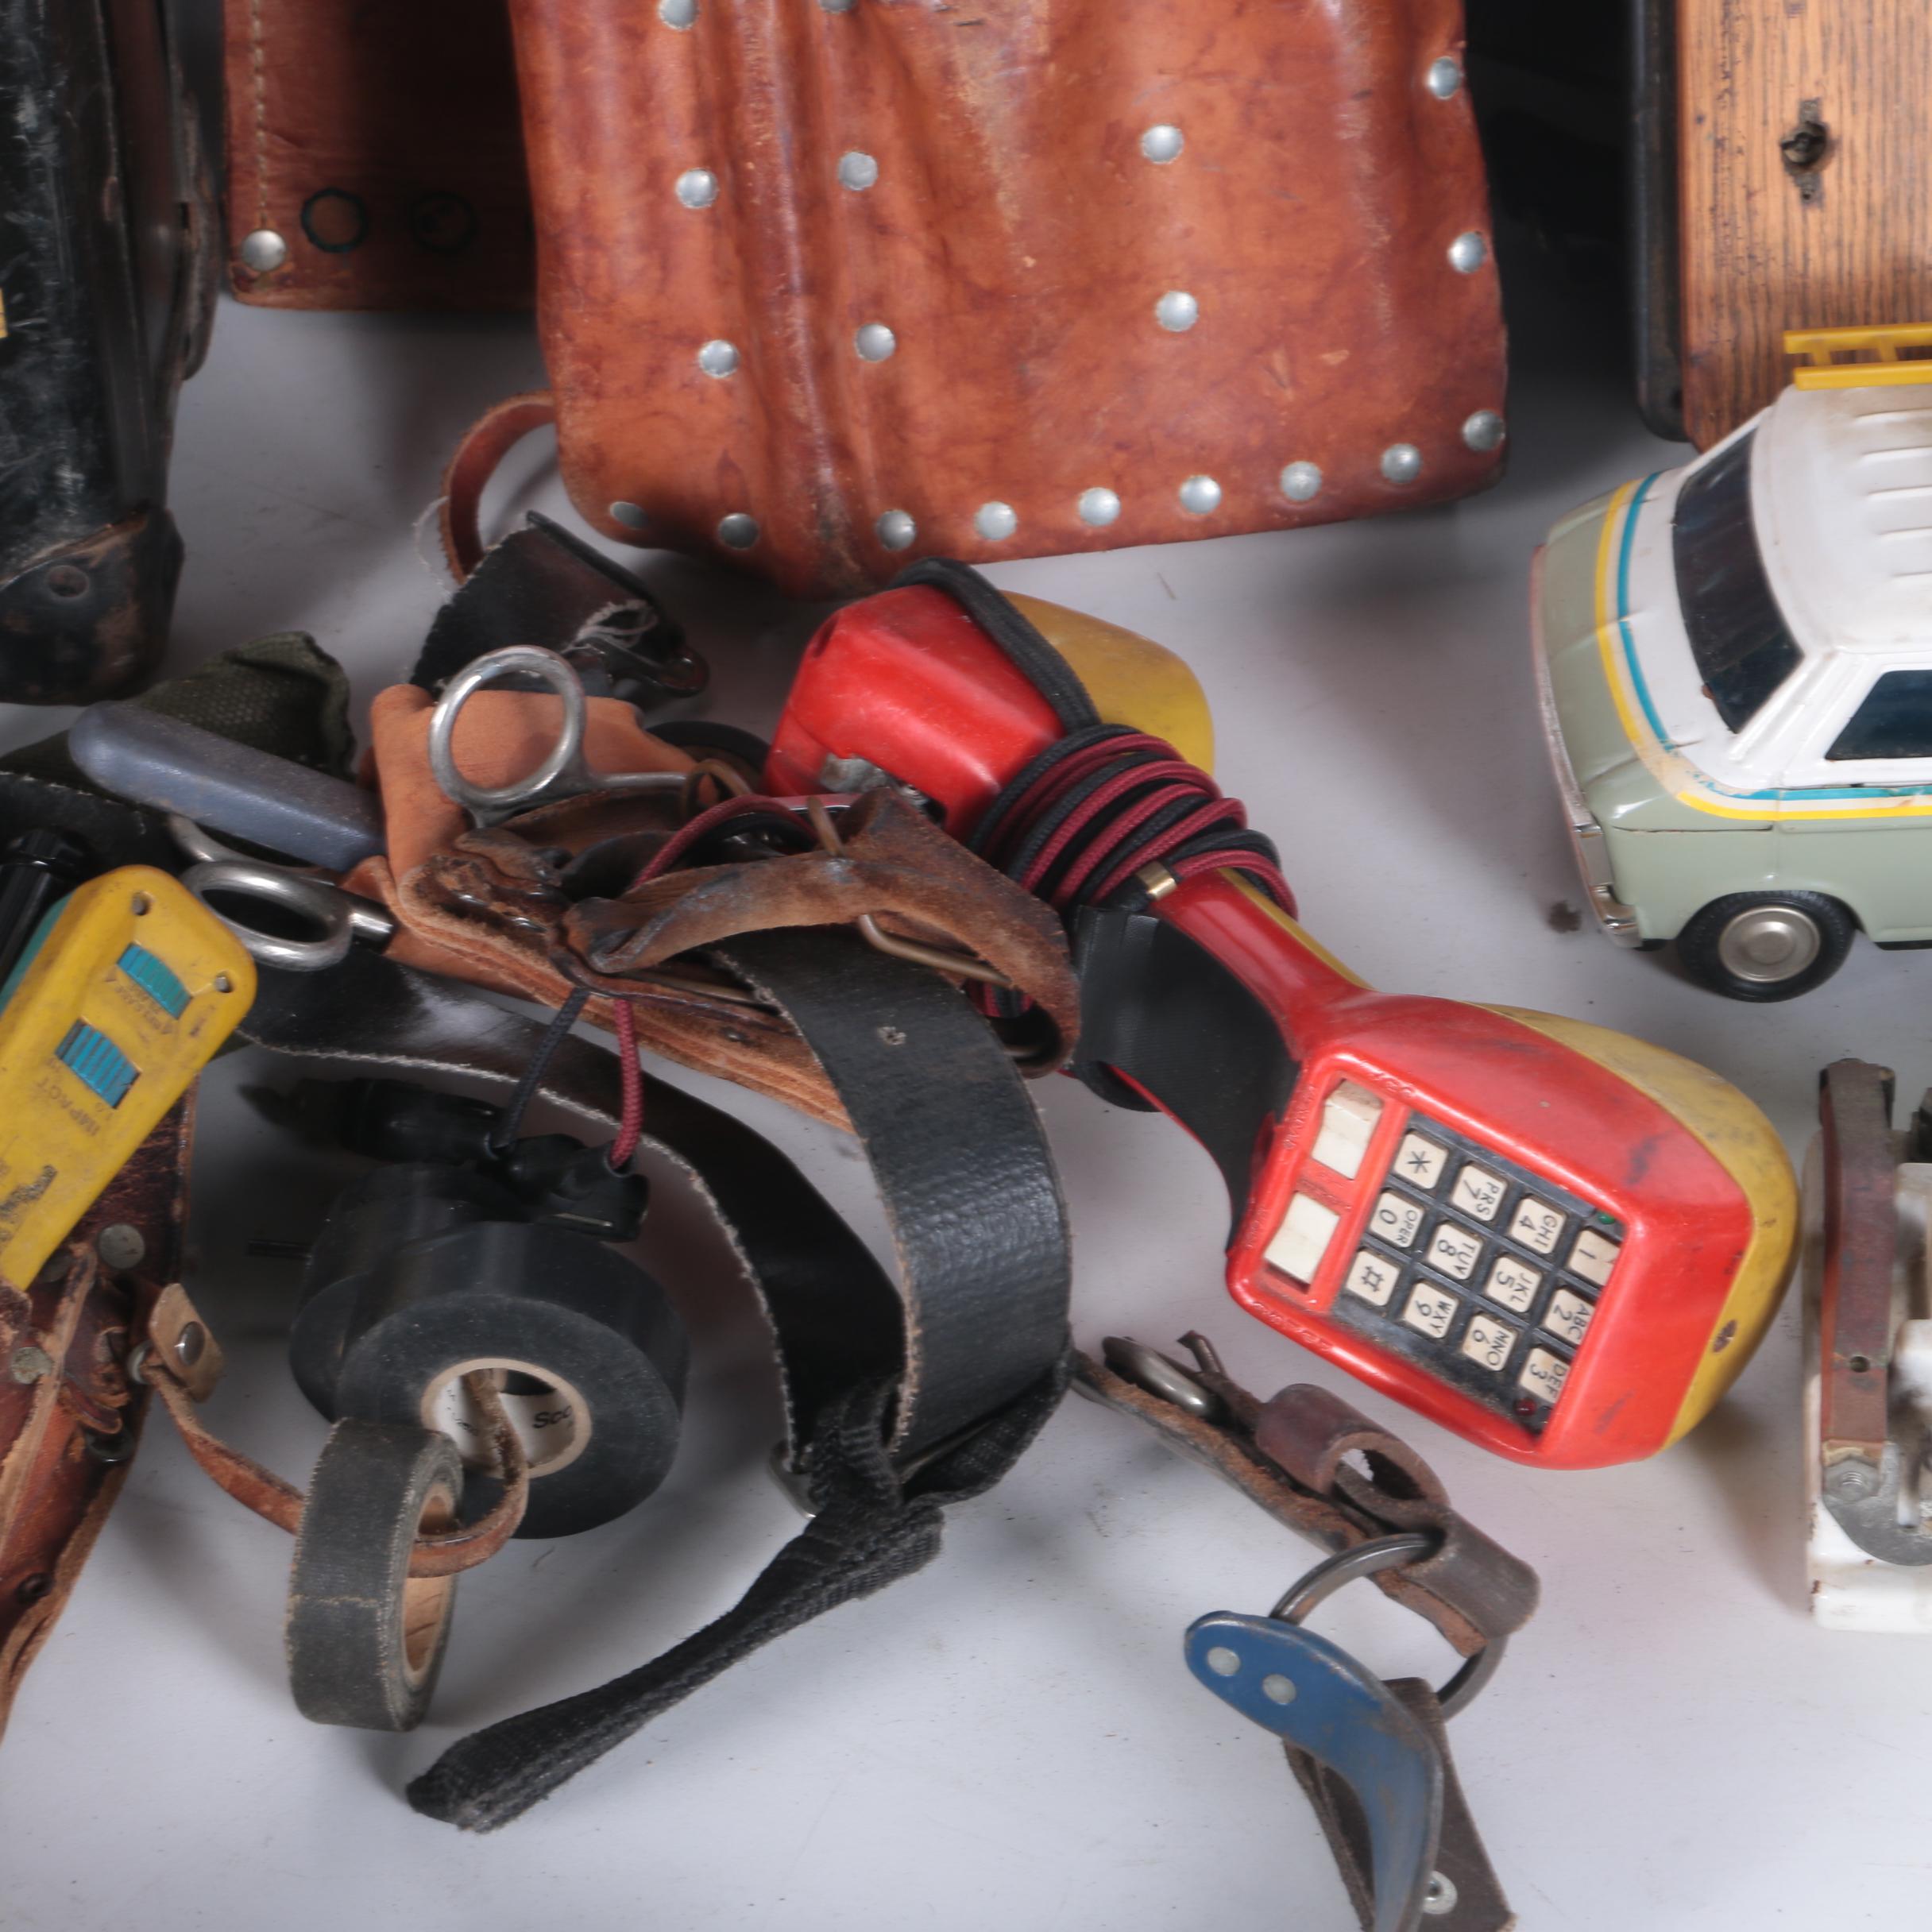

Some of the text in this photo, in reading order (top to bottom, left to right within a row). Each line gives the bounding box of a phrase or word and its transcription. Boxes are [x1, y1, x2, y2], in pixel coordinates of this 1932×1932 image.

[1463, 1179, 1480, 1200] 7
[1477, 1182, 1500, 1215] PRS
[1397, 1211, 1417, 1244] OPER
[1519, 1215, 1536, 1230] 4
[1534, 1215, 1557, 1247] GHI
[1437, 1239, 1456, 1256] 8
[1454, 1242, 1475, 1274] TUV
[1578, 1249, 1596, 1260] 1
[1496, 1272, 1513, 1288] 5
[1511, 1273, 1532, 1303] JKL
[1416, 1300, 1432, 1317] 9
[1431, 1301, 1453, 1334] WXY
[1555, 1304, 1572, 1321] 2
[1567, 1304, 1590, 1340] ABC
[1473, 1330, 1490, 1344] 6
[1486, 1331, 1509, 1366] MNO
[1530, 1364, 1548, 1379] 3
[1546, 1364, 1567, 1397] DEF
